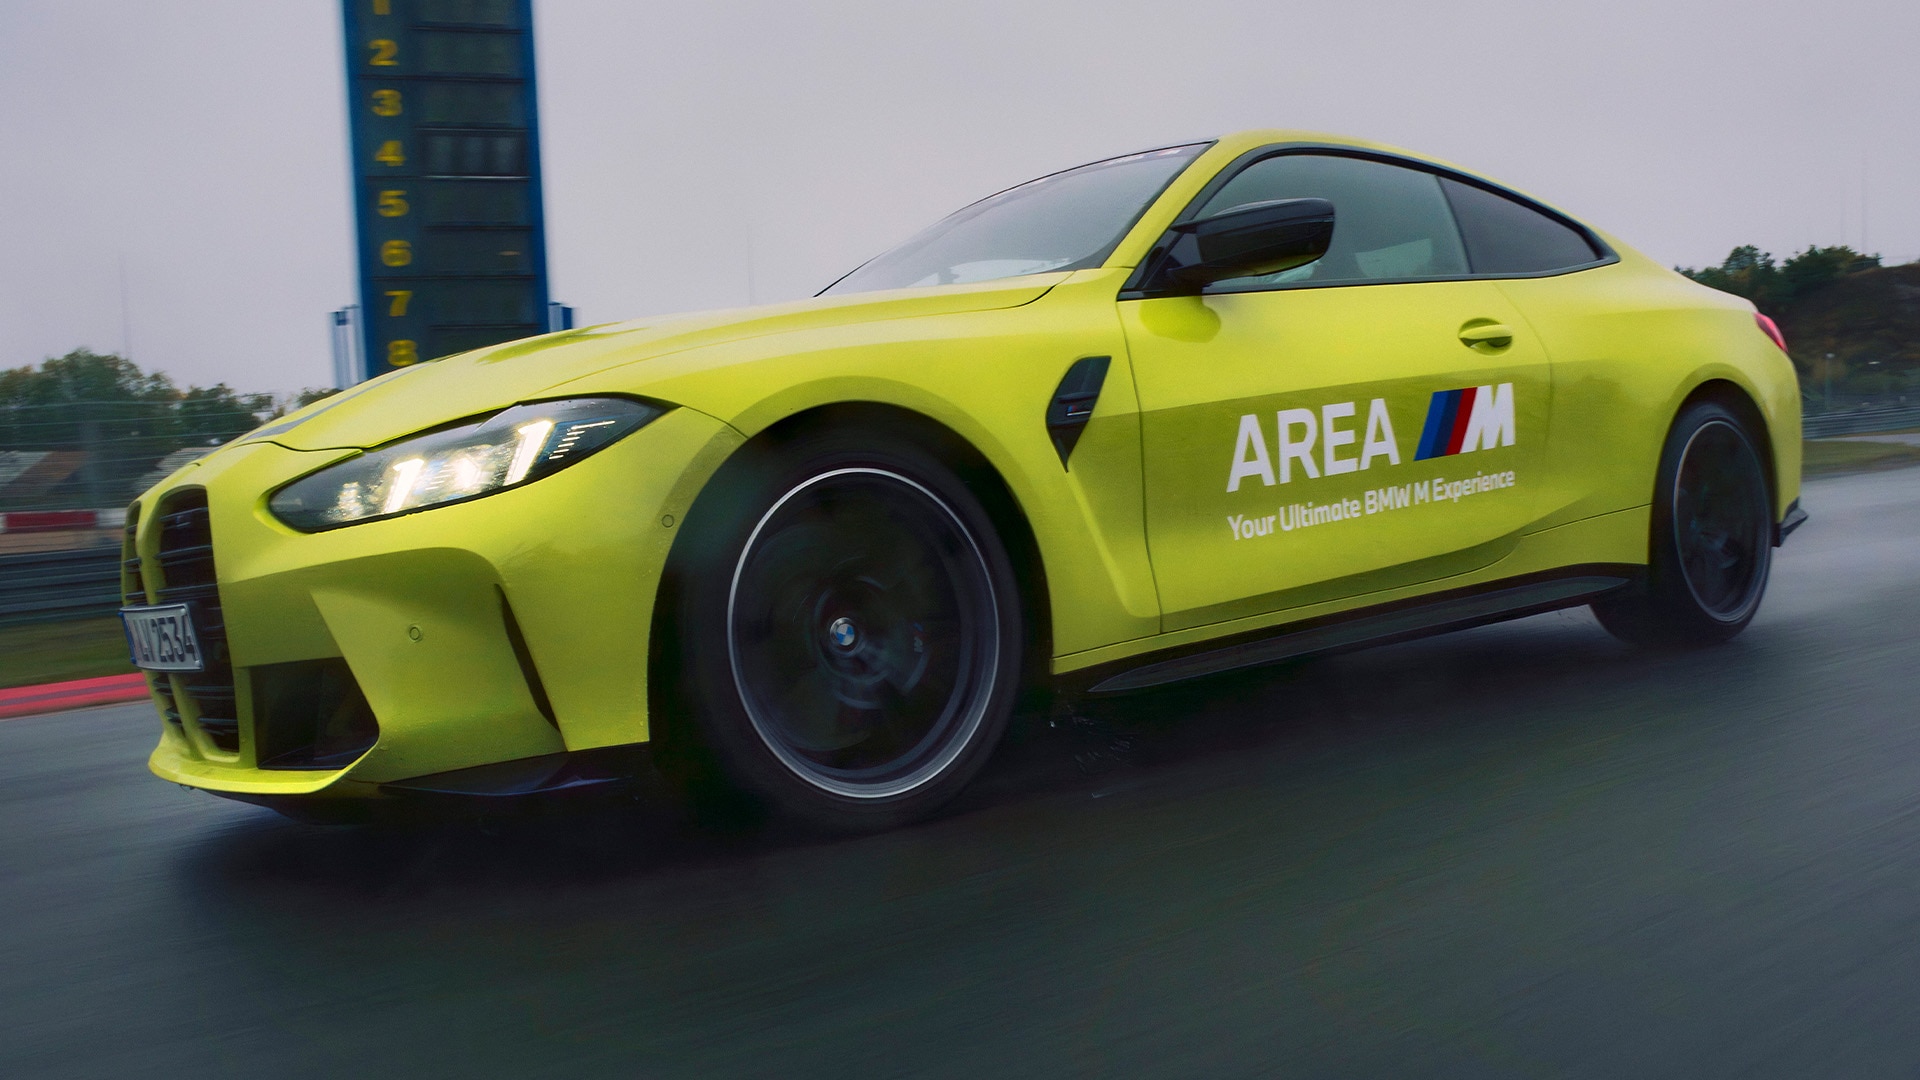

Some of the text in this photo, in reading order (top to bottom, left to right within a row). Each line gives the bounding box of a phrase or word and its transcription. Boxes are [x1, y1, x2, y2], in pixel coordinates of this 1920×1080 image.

[369, 39, 399, 66] 2
[370, 89, 402, 116] 3
[374, 140, 405, 166] 4
[378, 190, 409, 217] 5
[380, 239, 412, 267] 6
[384, 290, 413, 317] 7
[387, 339, 418, 367] 8
[1226, 398, 1400, 493] AREA
[1227, 470, 1515, 541] Your Ultimate BMW M Experience
[150, 615, 197, 662] 2534
